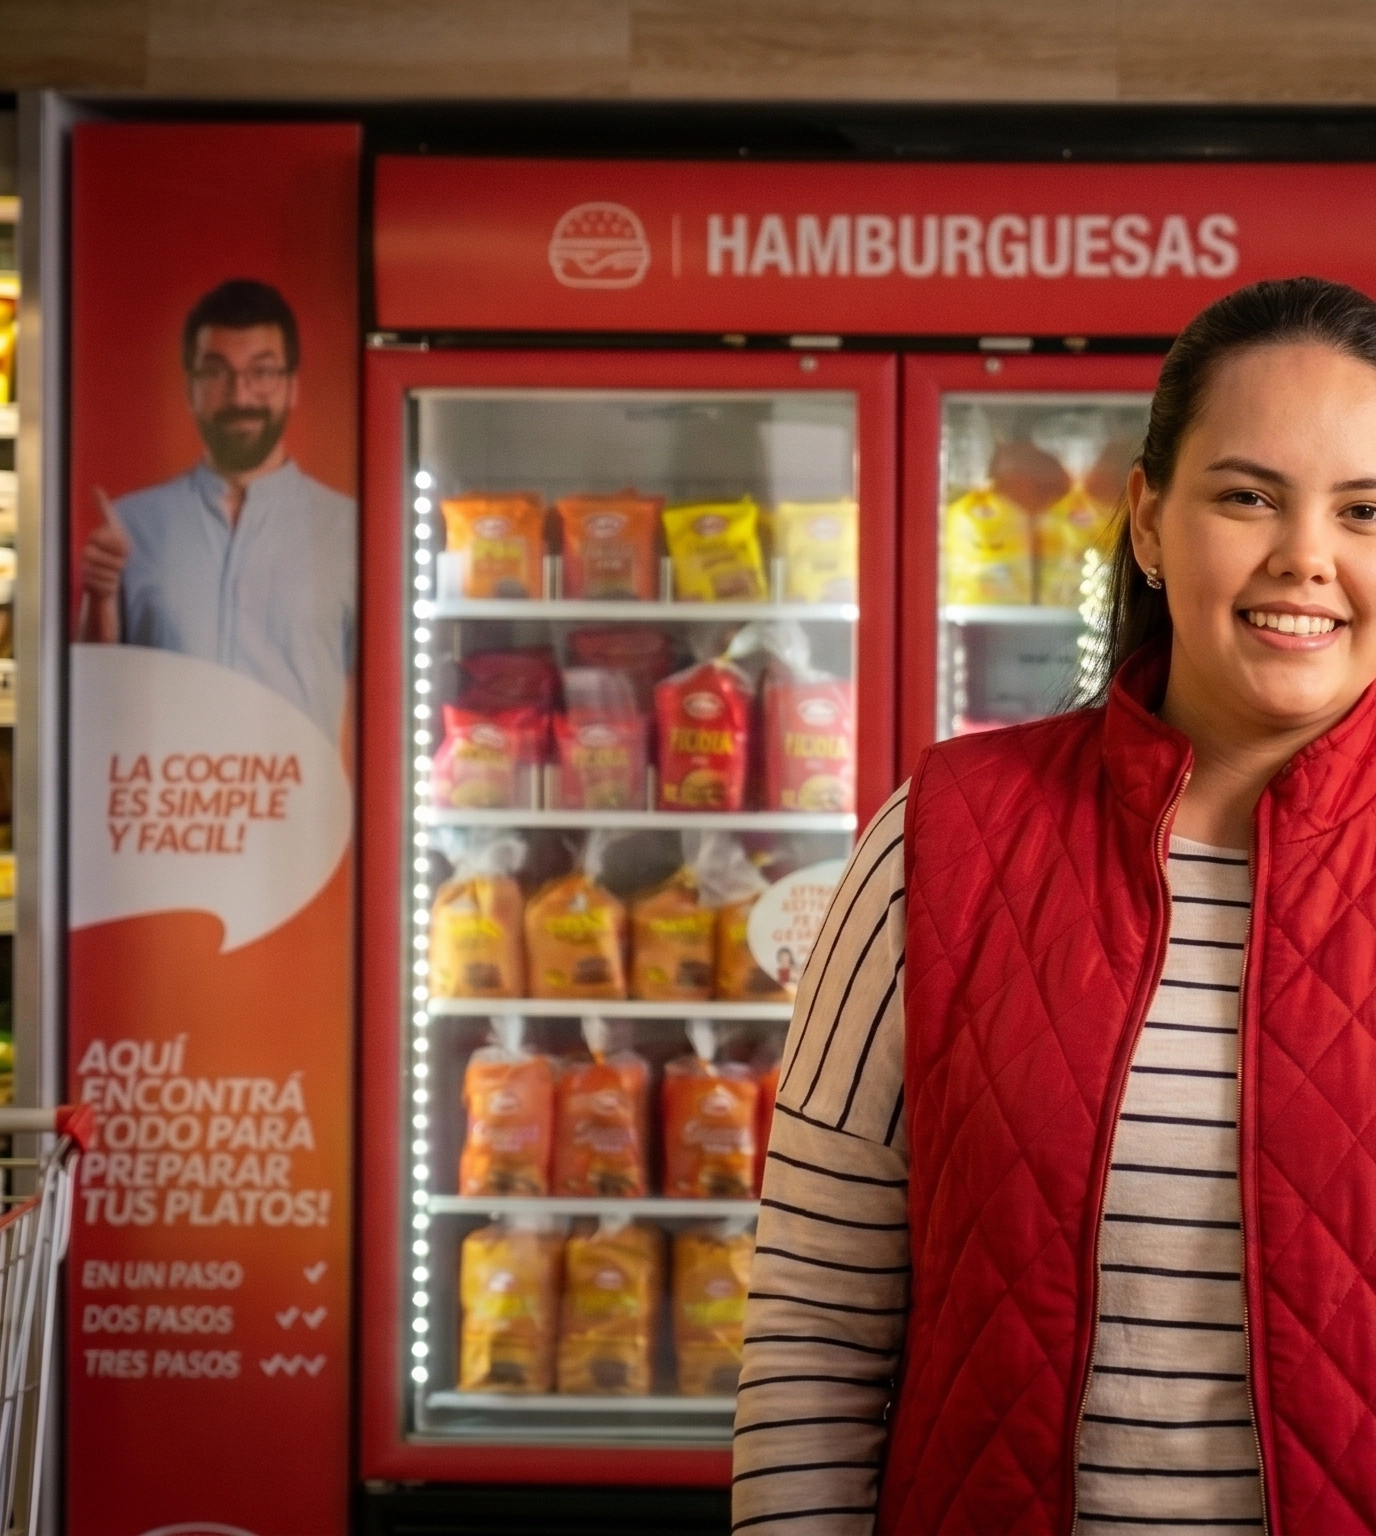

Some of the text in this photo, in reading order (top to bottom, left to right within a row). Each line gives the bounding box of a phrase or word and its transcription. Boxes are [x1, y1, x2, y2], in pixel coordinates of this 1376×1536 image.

[707, 213, 1239, 278] HAMBURGUESAS
[109, 754, 303, 785] LA COCINA
[107, 787, 288, 820] ES SIMPLE
[108, 823, 129, 854] Y
[78, 1033, 189, 1077] AQUÍ
[81, 1070, 306, 1113] ENCONTRÁ
[206, 1114, 315, 1150] PARA
[80, 1152, 291, 1188] PREPARAR
[83, 1190, 332, 1228] TUS PLATOS!
[82, 1260, 244, 1289] EN UN PASO
[82, 1304, 235, 1334] DOS PASOS
[84, 1349, 242, 1378] TRES PASOS
